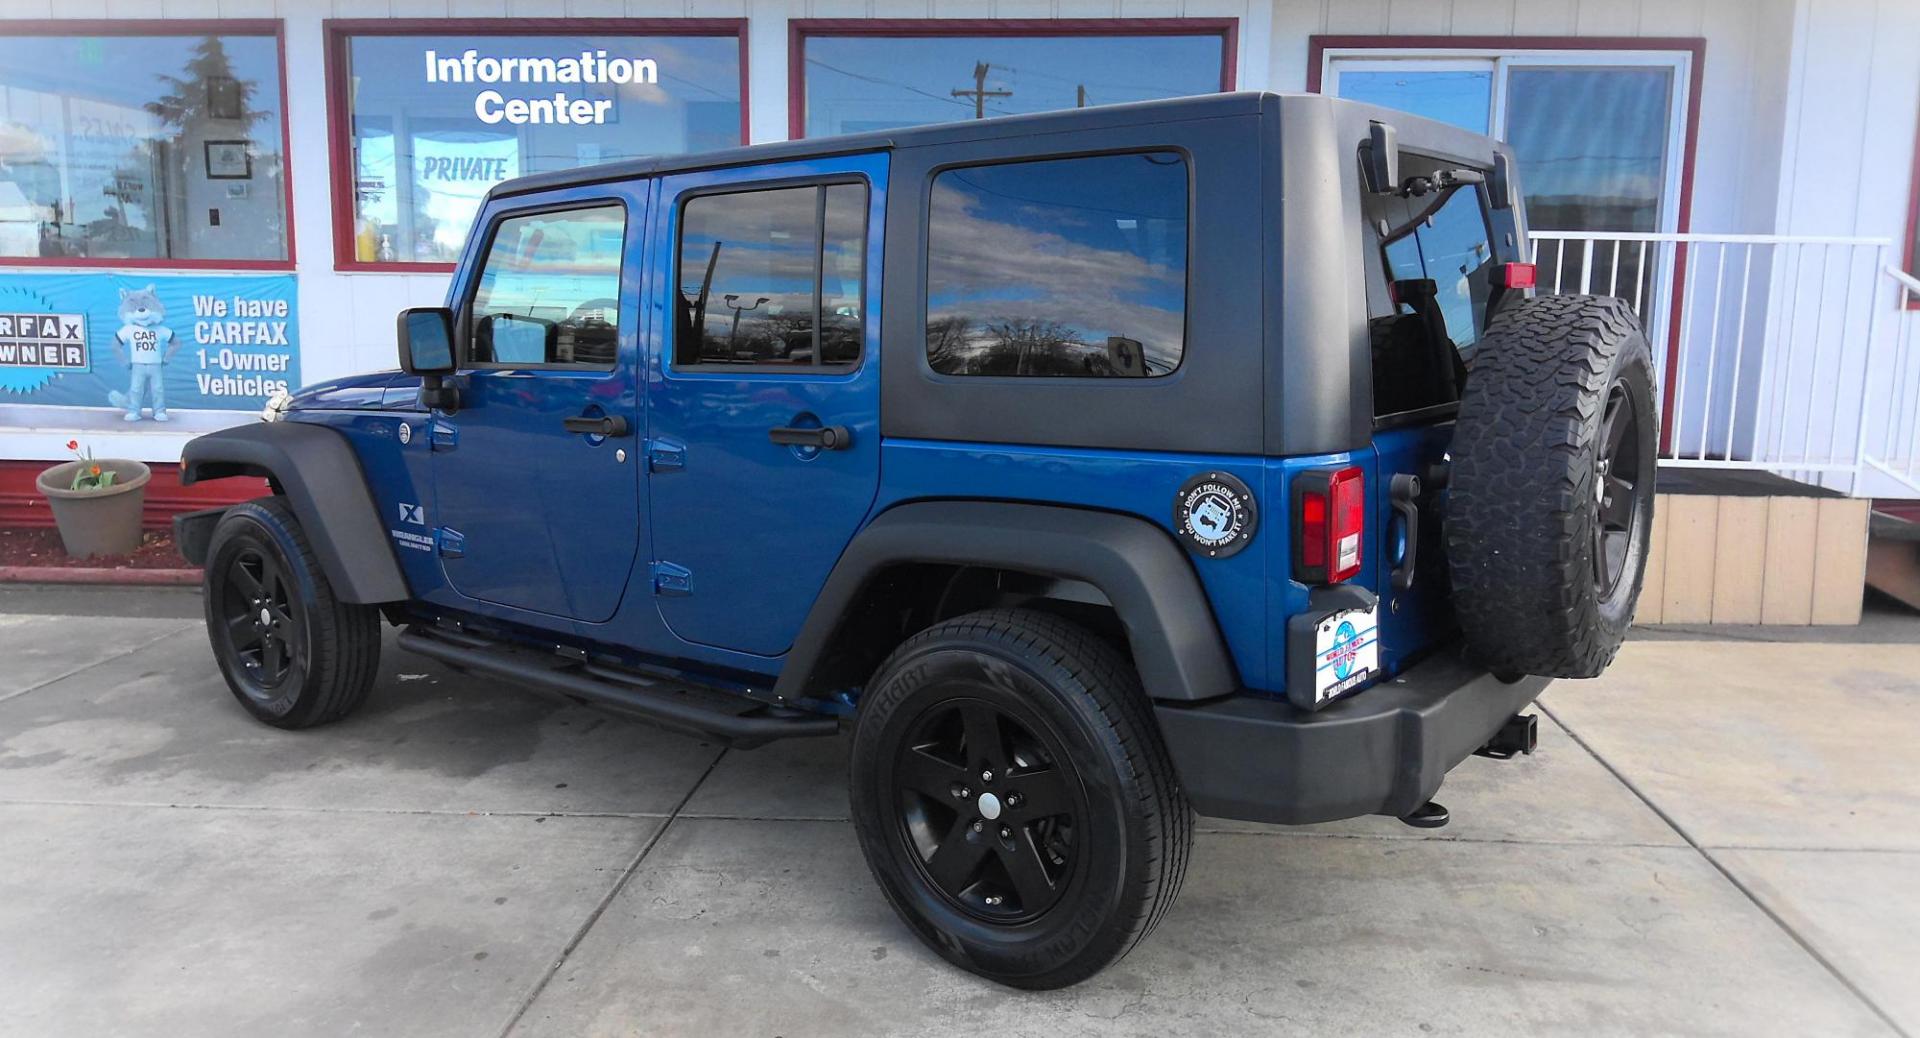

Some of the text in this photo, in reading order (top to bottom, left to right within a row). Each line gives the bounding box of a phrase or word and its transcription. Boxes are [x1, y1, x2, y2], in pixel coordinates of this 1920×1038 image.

[426, 50, 657, 84] Information
[475, 89, 612, 124] Center
[423, 156, 508, 181] PRIVATE
[192, 295, 288, 318] We have
[133, 331, 156, 341] CAR
[194, 321, 289, 345] CARFAX
[136, 341, 156, 351] FOX
[196, 348, 290, 371] 1-Owner
[196, 373, 288, 397] Vehicles
[1184, 484, 1242, 510] DON'T FOLLOW ME
[1184, 518, 1195, 535] YOU
[1218, 530, 1238, 546] MAKE
[1234, 522, 1242, 531] IT
